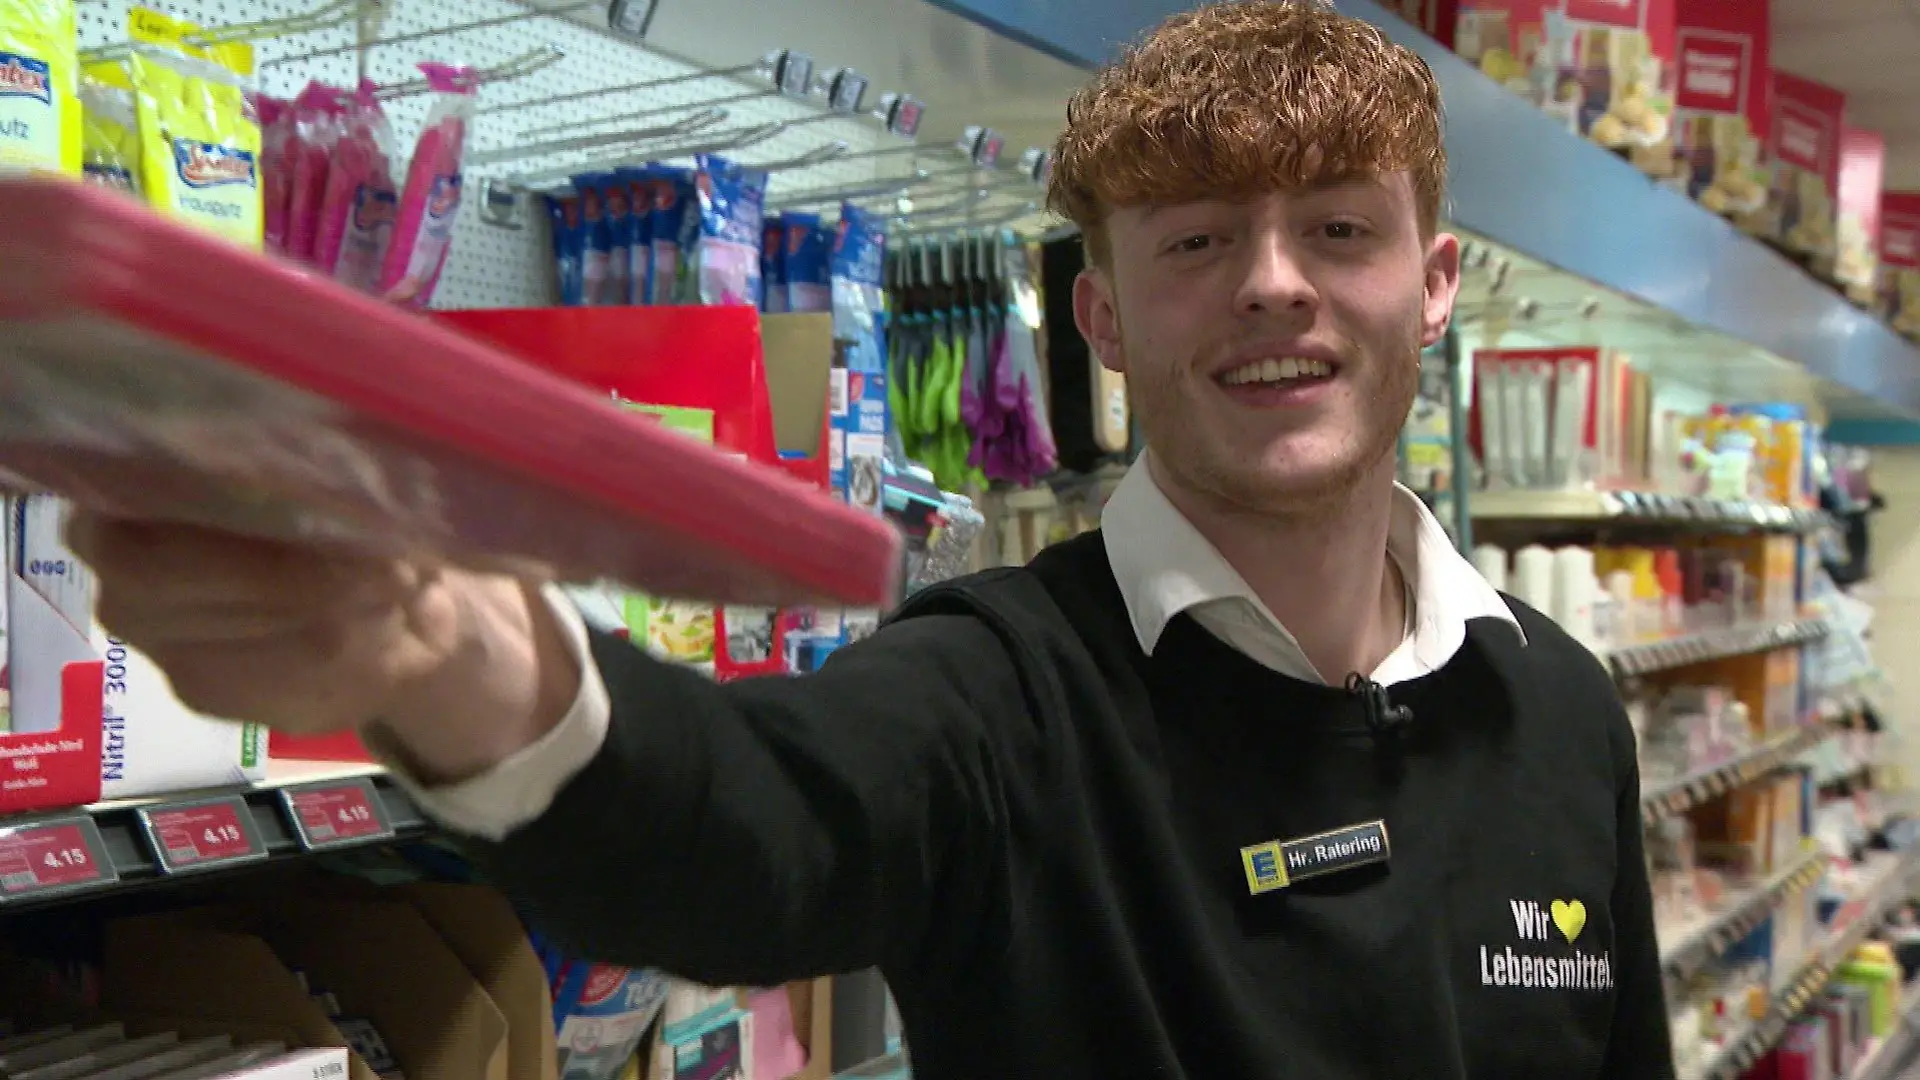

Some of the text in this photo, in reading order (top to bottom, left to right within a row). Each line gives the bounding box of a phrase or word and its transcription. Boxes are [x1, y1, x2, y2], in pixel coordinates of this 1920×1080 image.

[43, 847, 87, 869] 4.15
[1288, 835, 1382, 870] Hr. Ratering
[1509, 898, 1550, 942] Wir
[1479, 944, 1615, 991] Lebensmittel.
